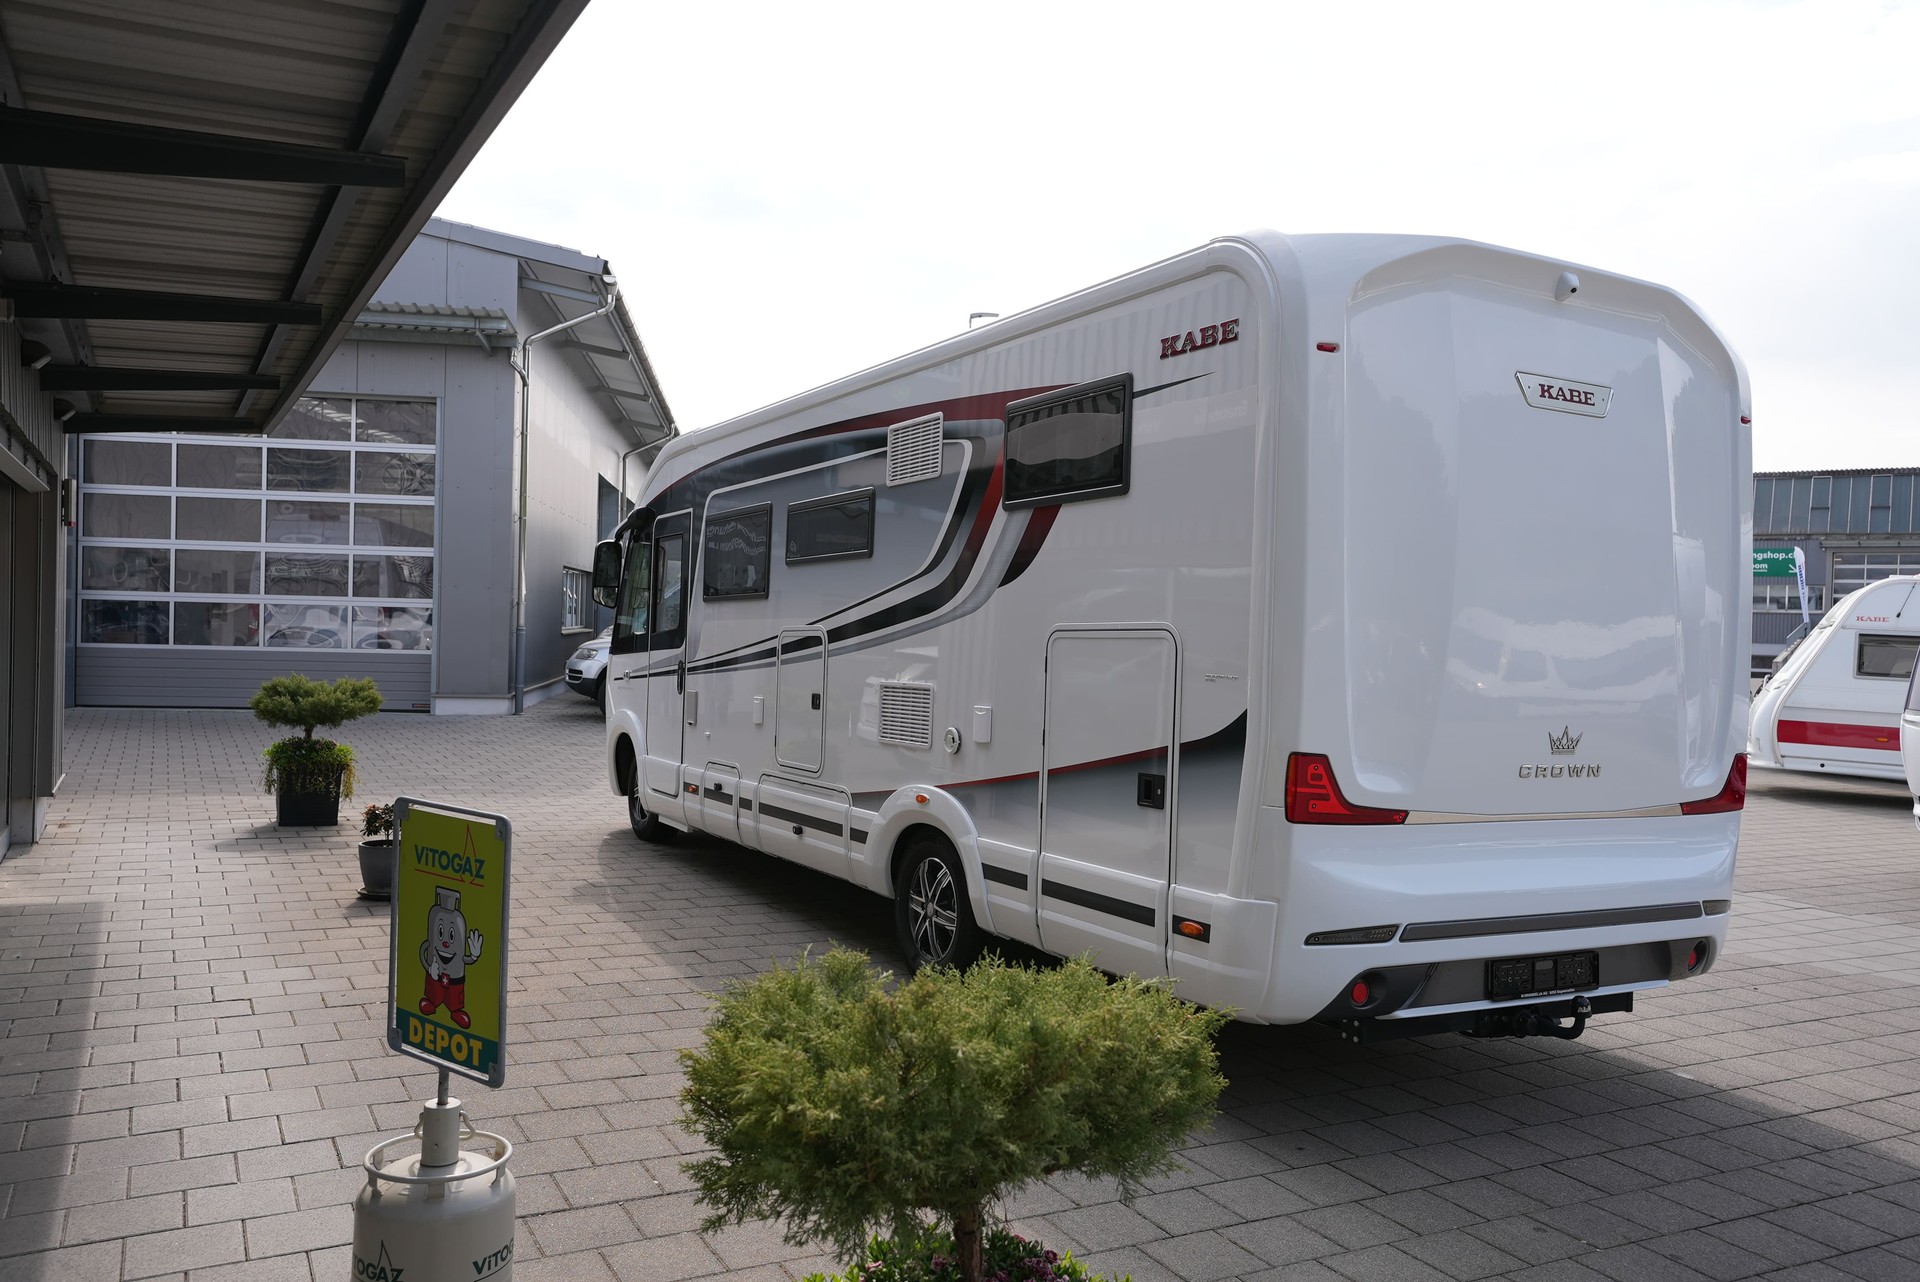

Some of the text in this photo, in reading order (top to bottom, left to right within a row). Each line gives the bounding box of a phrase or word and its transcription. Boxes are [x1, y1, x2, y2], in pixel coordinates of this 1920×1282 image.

[1160, 317, 1240, 360] KABE
[1538, 383, 1596, 407] KABE
[1753, 551, 1795, 561] ngshop.c
[1855, 615, 1890, 623] KABE
[1518, 763, 1601, 779] CROWN
[409, 1016, 483, 1067] DEPOT
